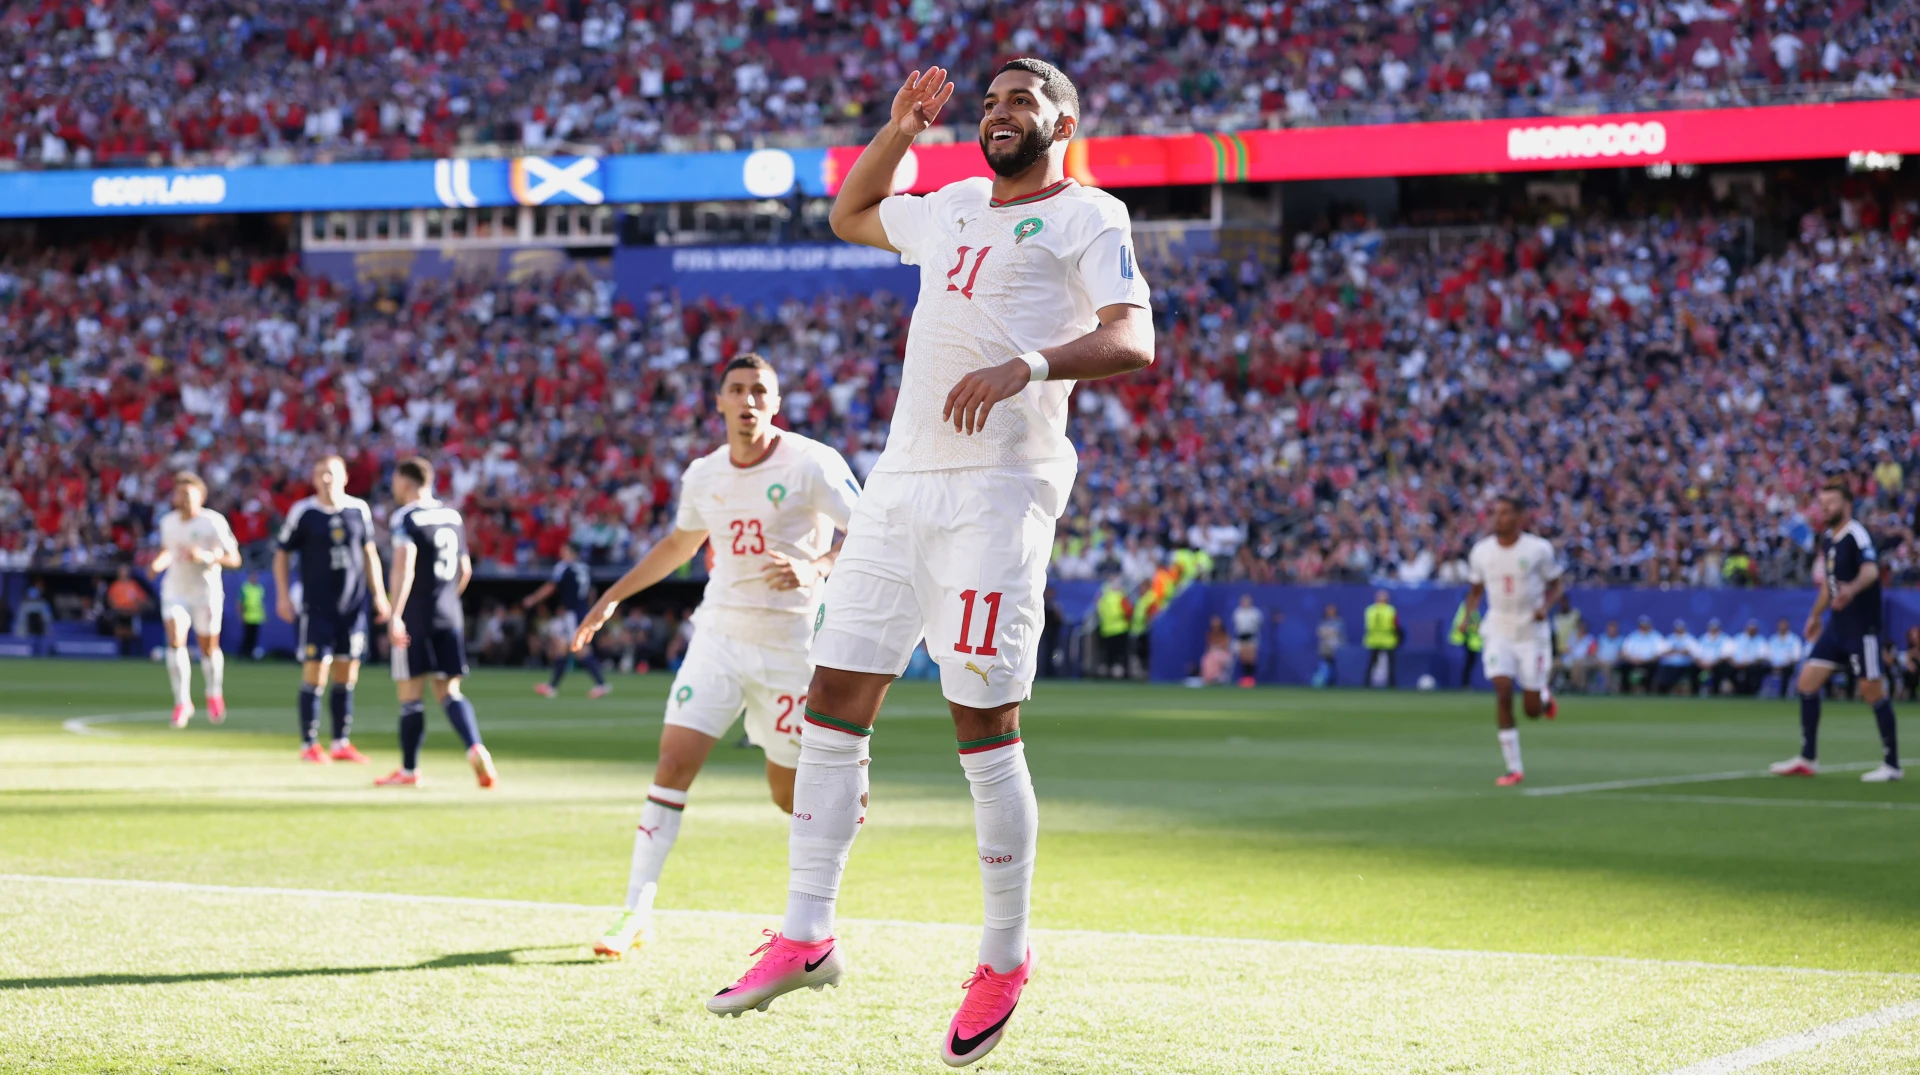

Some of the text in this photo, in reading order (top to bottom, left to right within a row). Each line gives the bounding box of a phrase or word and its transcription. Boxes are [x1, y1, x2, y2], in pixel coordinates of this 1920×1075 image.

[1508, 121, 1666, 160] MOROCCO
[92, 174, 226, 207] SCOTLAND
[672, 249, 713, 270] FIFA
[718, 248, 784, 270] WORLD
[788, 247, 826, 269] CUP
[433, 527, 459, 581] 3
[729, 519, 766, 556] 23
[953, 589, 1004, 656] 11
